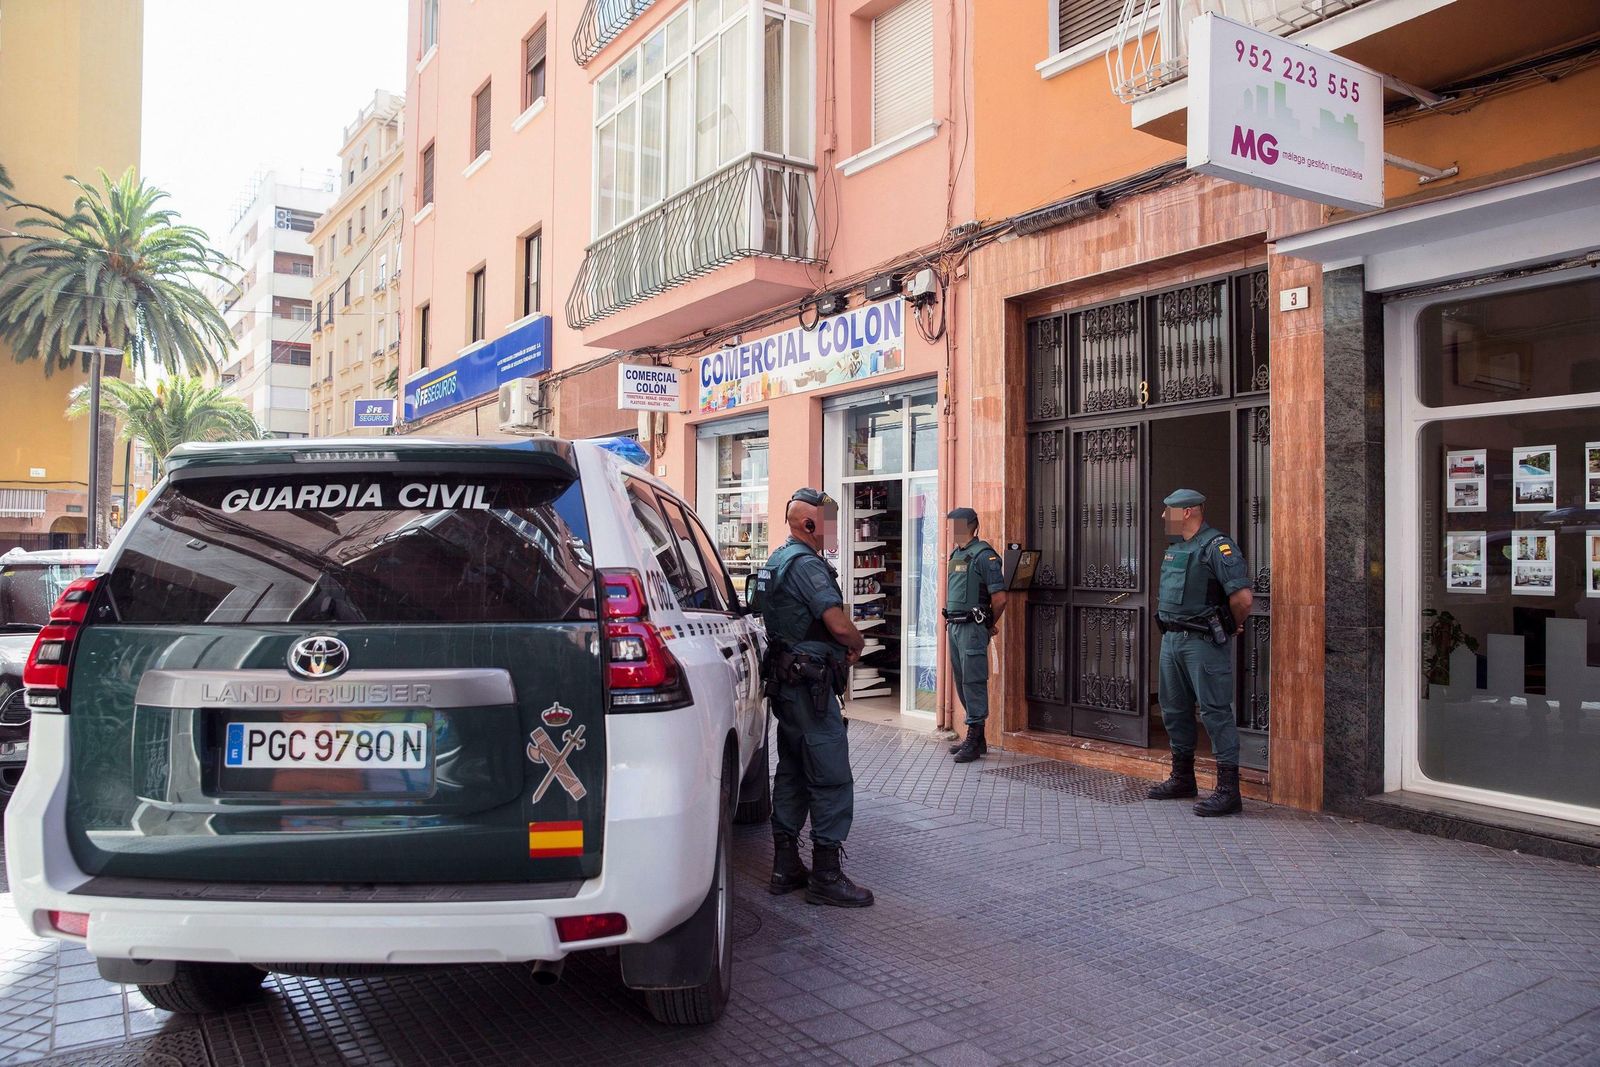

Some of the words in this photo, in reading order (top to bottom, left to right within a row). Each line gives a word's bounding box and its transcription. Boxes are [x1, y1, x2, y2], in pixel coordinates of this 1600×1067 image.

[1235, 40, 1272, 72] 952
[1283, 57, 1318, 88] 223
[1328, 73, 1360, 102] 555
[1231, 125, 1279, 165] MG
[1330, 164, 1363, 180] inmobiliaria
[1290, 292, 1297, 306] 3
[702, 328, 811, 388] COMERCIAL
[817, 300, 901, 357] COLON
[625, 370, 678, 383] COMERCIAL
[636, 381, 667, 394] COLÓN
[1138, 381, 1149, 404] 3
[221, 484, 382, 513] GUARDIA
[399, 483, 491, 510] CIVIL
[202, 684, 281, 702] LAND
[292, 683, 432, 703] CRUISER
[231, 749, 238, 758] E
[248, 729, 306, 761] PGC
[314, 730, 394, 761] 9780
[402, 730, 422, 762] N
